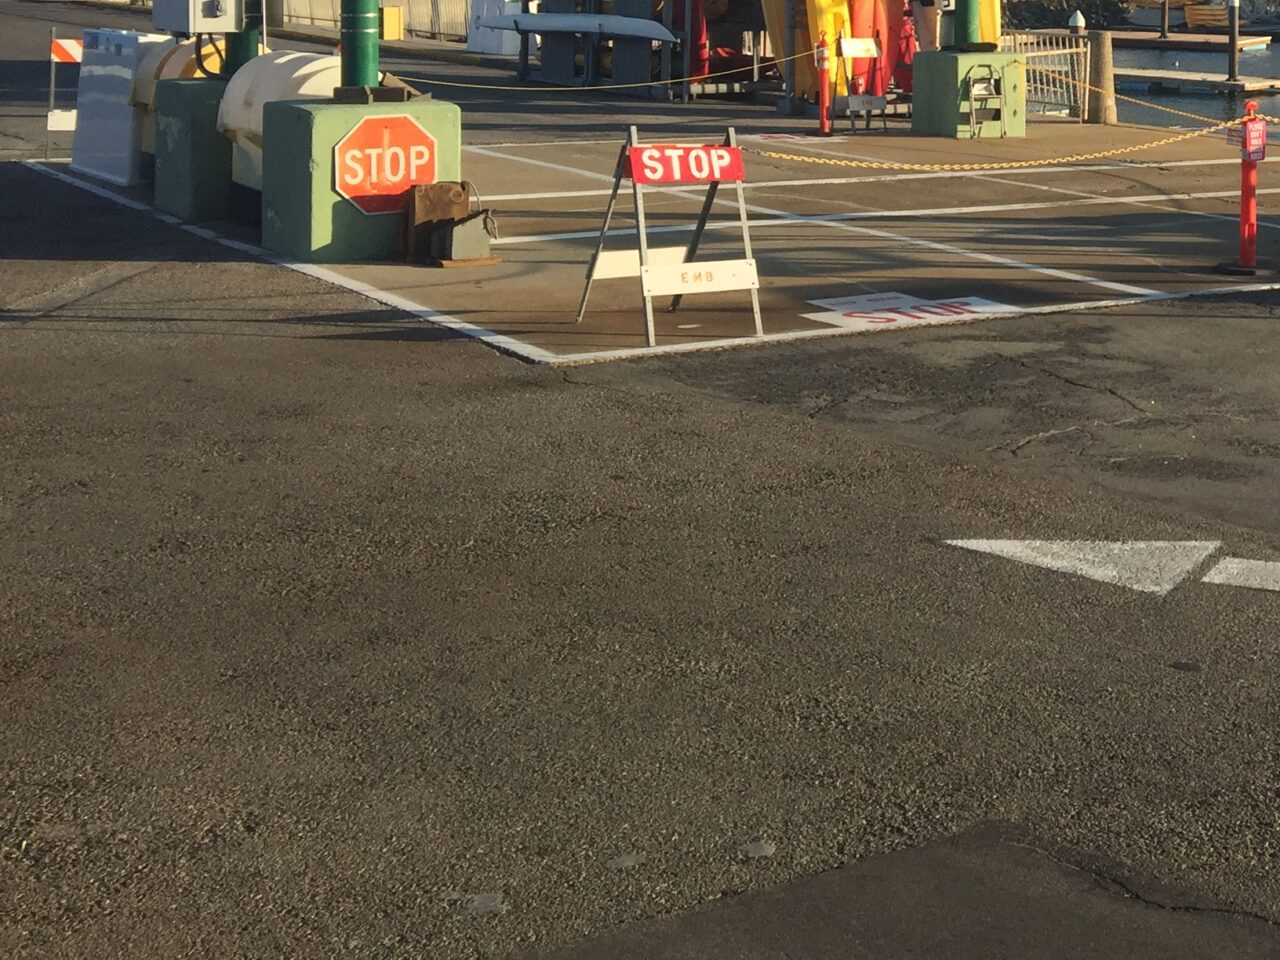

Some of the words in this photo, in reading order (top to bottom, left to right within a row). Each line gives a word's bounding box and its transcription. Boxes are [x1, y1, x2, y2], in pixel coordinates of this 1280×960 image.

[344, 145, 430, 185] STOP
[642, 149, 731, 180] STOP
[842, 301, 979, 324] STOP
